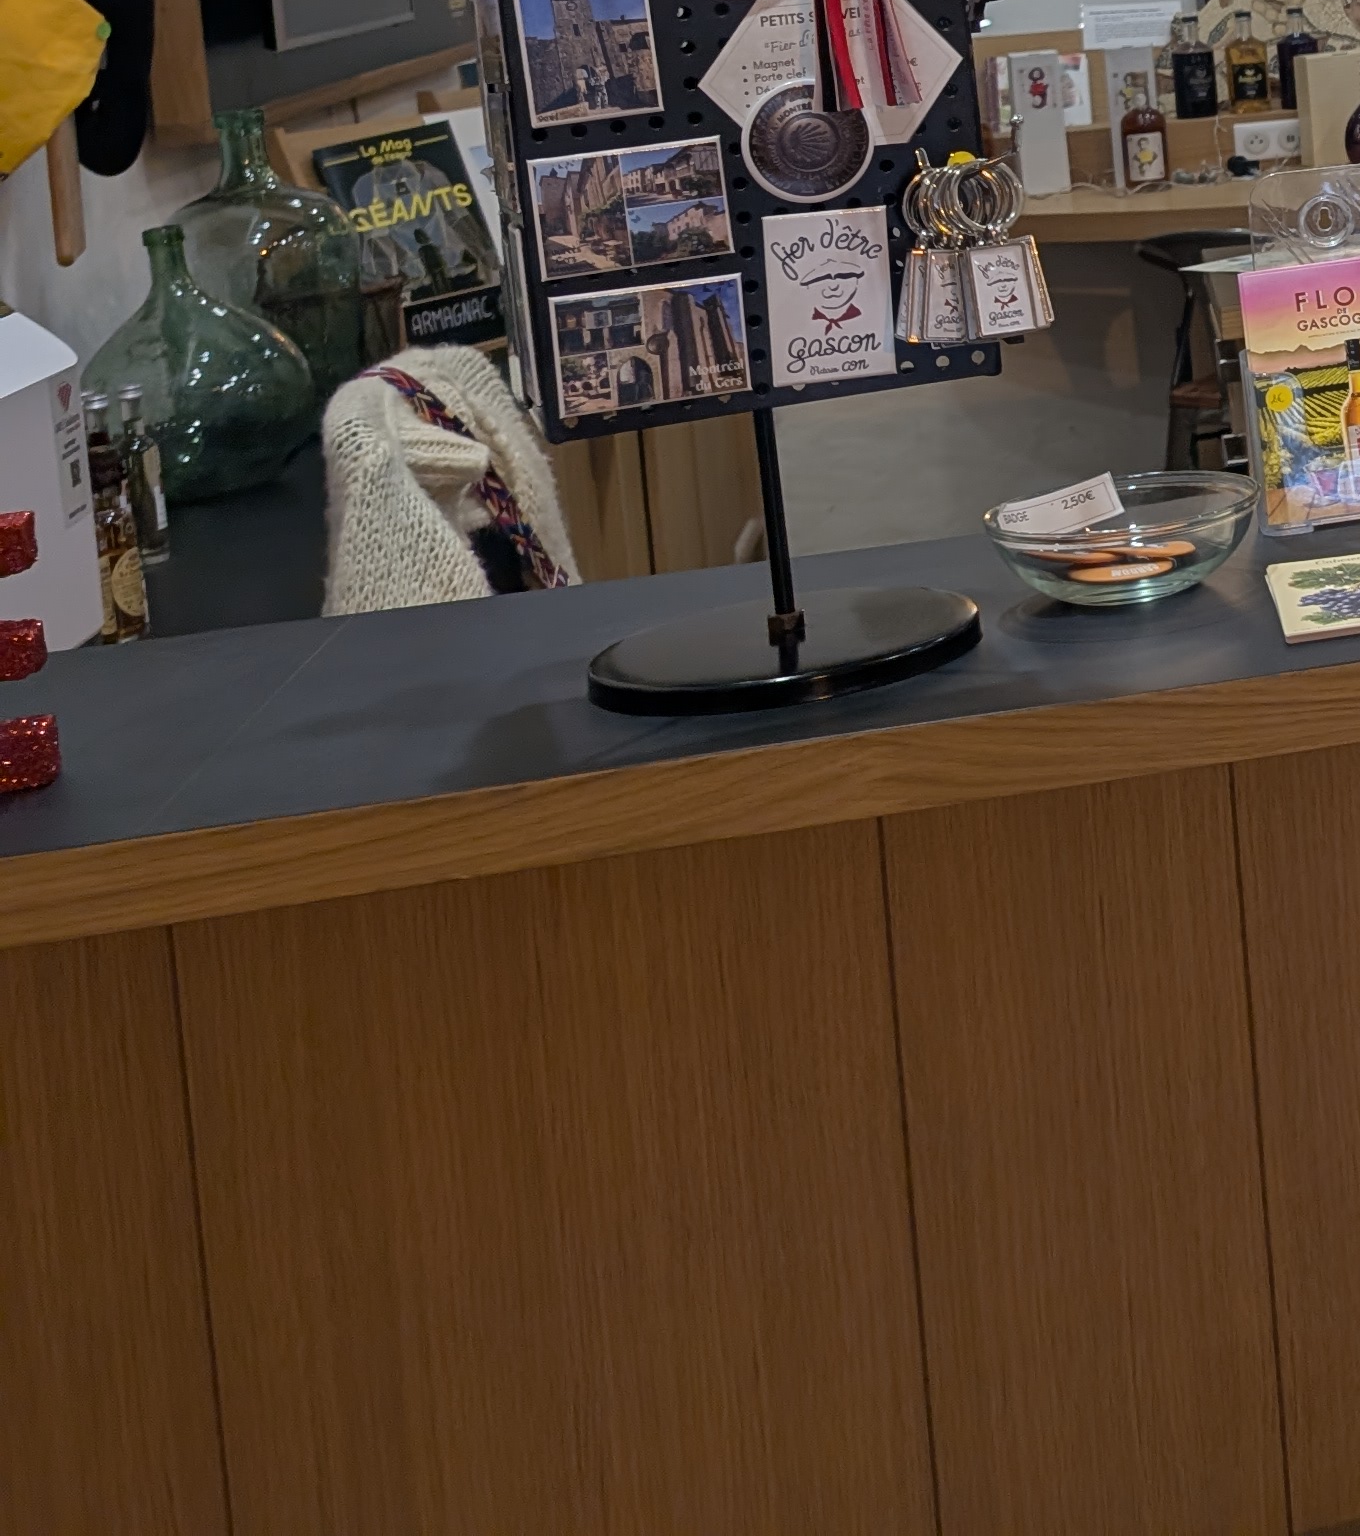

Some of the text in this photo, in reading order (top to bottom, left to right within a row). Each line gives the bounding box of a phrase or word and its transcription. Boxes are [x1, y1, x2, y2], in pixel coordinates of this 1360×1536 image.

[760, 13, 805, 27] PETITS
[753, 58, 795, 71] Magnet
[755, 70, 783, 82] Porte
[360, 138, 413, 158] Le Mag
[350, 181, 474, 234] GÉANTS
[819, 218, 884, 260] d'être
[411, 295, 495, 337] ARMAGNAC
[688, 358, 745, 377] Montréal
[841, 358, 870, 373] con
[695, 375, 744, 393] du Gers
[1061, 489, 1096, 511] 2,50€
[1002, 511, 1030, 525] BADGE
